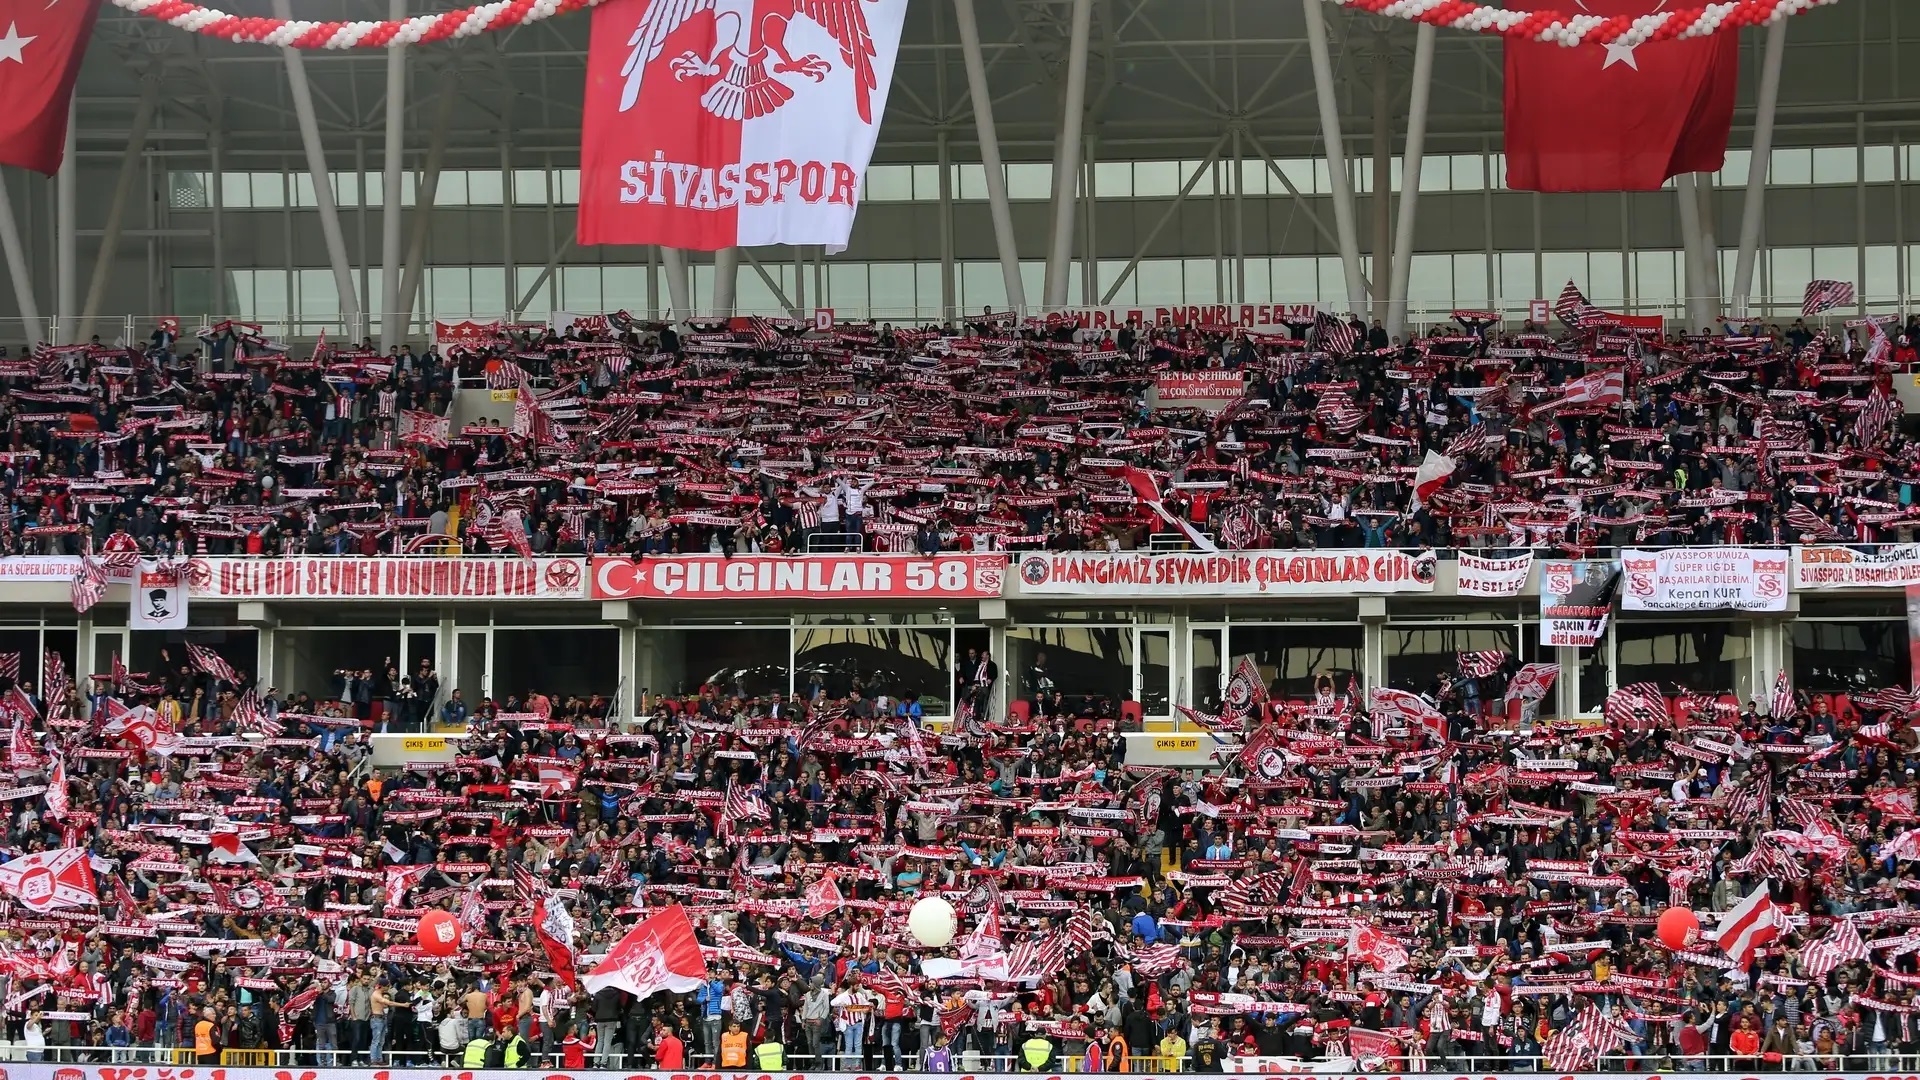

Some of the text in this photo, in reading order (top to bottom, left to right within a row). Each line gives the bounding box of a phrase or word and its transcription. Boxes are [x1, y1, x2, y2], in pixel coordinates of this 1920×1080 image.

[619, 149, 855, 211] SİVASSPOR
[1532, 303, 1547, 322] E
[818, 312, 832, 330] D
[1160, 371, 1179, 381] BEN
[493, 392, 509, 400] ÇIKIŞ
[1170, 388, 1187, 398] ÇOK
[1853, 499, 1893, 509] SİVASSPOR
[1660, 551, 1750, 560] SİVASSPOR'UMUZA
[15, 561, 40, 575] SÜPER
[1460, 556, 1530, 571] MEMLEKET
[1674, 561, 1703, 573] SÜPER
[1052, 552, 1409, 592] HANGİMİZ SEVMEDİK ÇILGINLAR GİBİ
[220, 561, 260, 595] DELİ
[265, 561, 301, 595] GİBİ
[503, 560, 538, 595] VAR
[653, 561, 968, 595] ÇILGINLAR 58
[1659, 576, 1711, 586] BAŞARILAR
[1668, 588, 1742, 599] Kenan KURT
[1642, 600, 1697, 610] Sancaktepe
[1735, 600, 1768, 609] Müdürü
[1553, 620, 1584, 631] SAKIN
[1551, 631, 1595, 645] BİZİ BIRAK
[1287, 732, 1324, 741] SİVASSPOR
[405, 740, 424, 749] ÇIKIŞ
[1156, 740, 1176, 749] ÇIKIŞ
[1180, 740, 1197, 748] EXIT
[1508, 778, 1544, 786] SİVASSPOR
[1018, 828, 1053, 836] SİVASSPOR
[1070, 828, 1109, 837] SİVASSPOR
[1628, 833, 1670, 841] SİVASSPOR
[445, 865, 487, 873] SİVASSPOR
[1536, 861, 1580, 870] SİVASSPOR
[331, 867, 374, 879] SİVASSPOR
[1191, 879, 1230, 887] SİVASSPOR
[1578, 879, 1622, 887] SİVASSPOR
[1466, 885, 1509, 894] SİVASSPOR
[53, 911, 98, 922] SİVASSPOR
[1293, 907, 1339, 916] SİVASSPOR
[20, 921, 62, 929] SİVASSPOR
[110, 927, 145, 935] SİVASSPOR
[260, 950, 302, 958] SİVASSPOR
[1610, 974, 1654, 987] SİVASSPOR
[57, 991, 99, 999] YİĞİDOLAR
[1636, 991, 1677, 1004] SİVASSPOR
